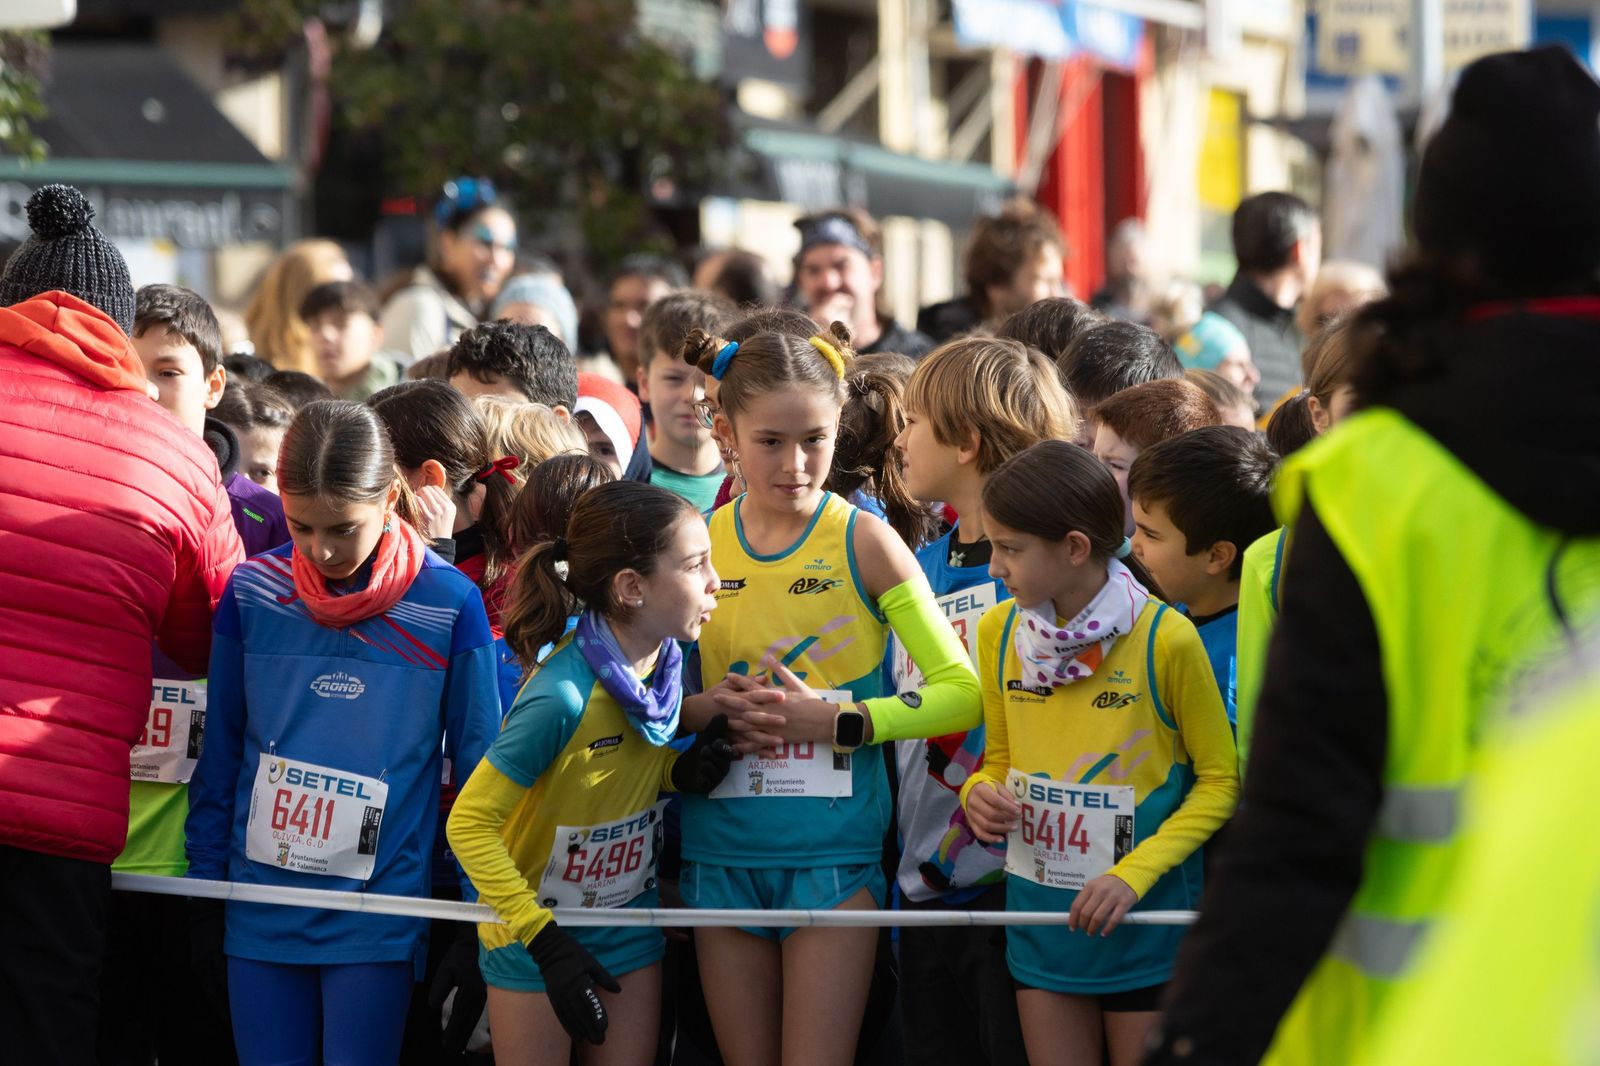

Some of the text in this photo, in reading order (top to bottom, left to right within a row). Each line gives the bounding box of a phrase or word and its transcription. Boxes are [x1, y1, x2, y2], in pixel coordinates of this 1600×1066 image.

[310, 681, 366, 693] CRONOS
[747, 761, 789, 770] ARIADNA
[285, 767, 371, 800] SETEL
[765, 778, 806, 787] Ayuntamiento
[765, 786, 805, 794] de Salamanca
[1029, 783, 1119, 810] SETEL
[271, 788, 335, 840] 6411
[590, 811, 651, 843] SETE
[1021, 803, 1090, 854] 6414
[290, 852, 329, 865] Ayuntamiento
[562, 834, 645, 884] 6496
[296, 862, 328, 873] Salamanca
[1047, 869, 1085, 879] Ayuntamiento
[587, 878, 617, 890] MARINA
[585, 988, 603, 1020] KIPSTA
